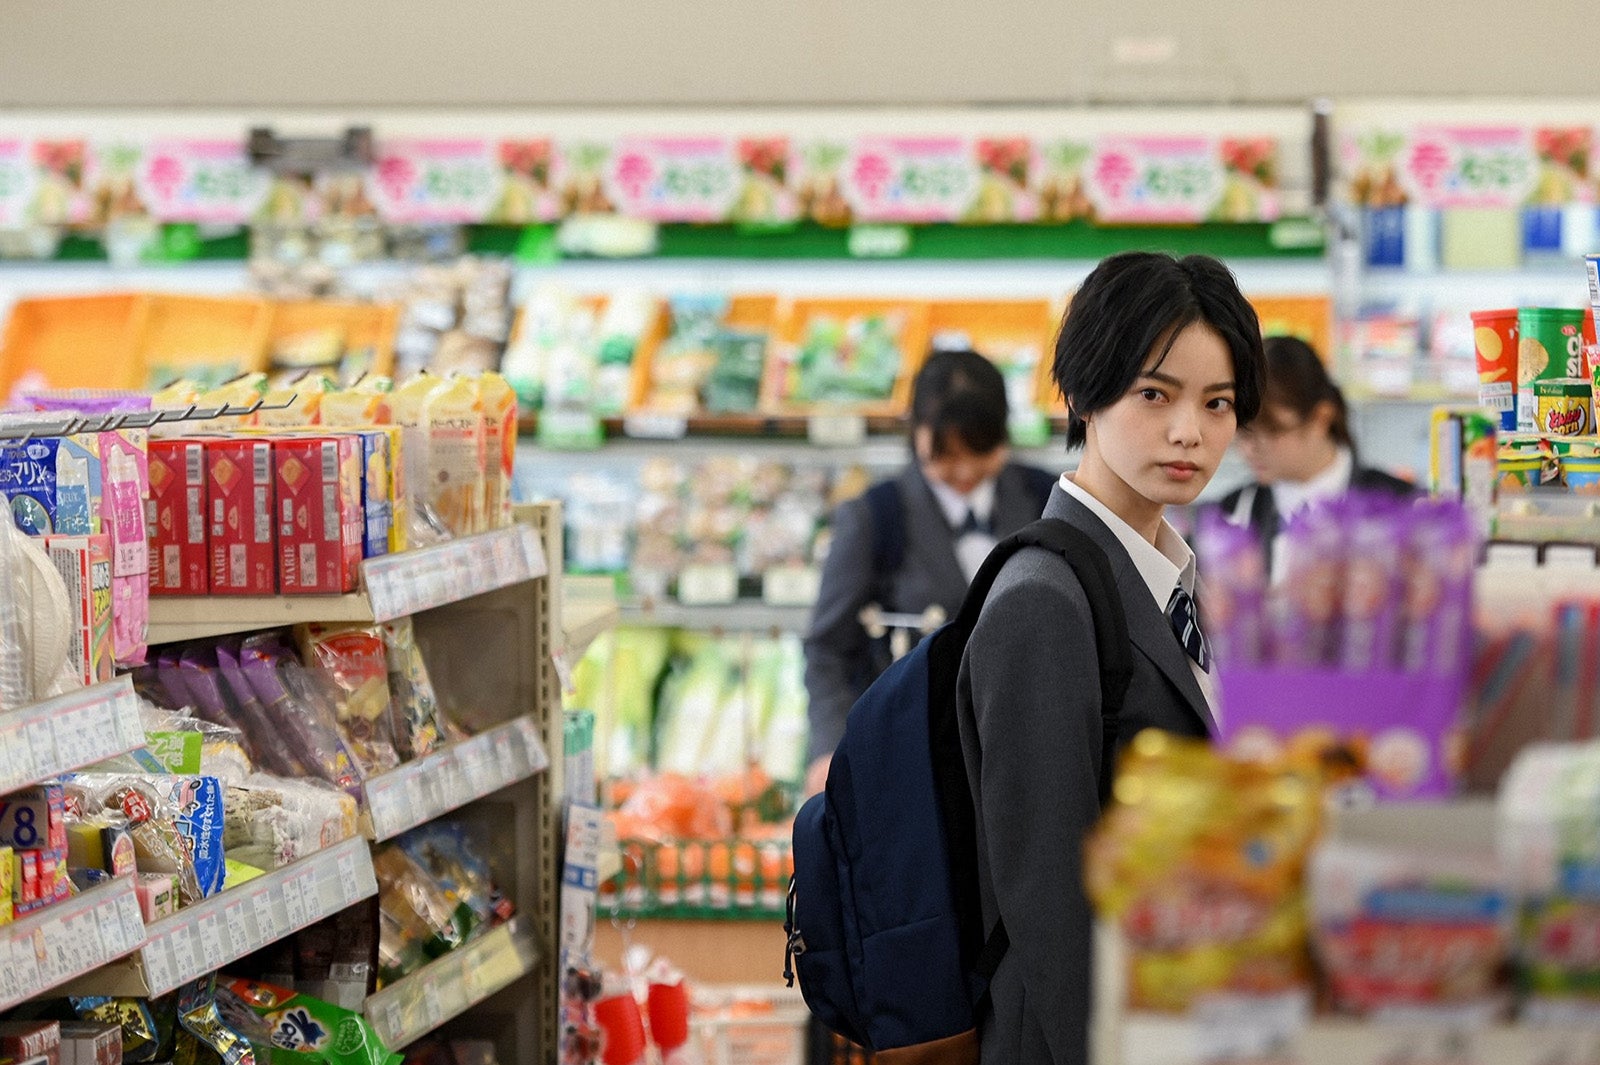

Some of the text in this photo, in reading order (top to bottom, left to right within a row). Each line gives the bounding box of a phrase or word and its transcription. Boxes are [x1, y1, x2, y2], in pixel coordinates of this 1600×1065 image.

[215, 545, 225, 586] MARIE
[285, 545, 295, 586] MARIE
[14, 806, 37, 846] 8
